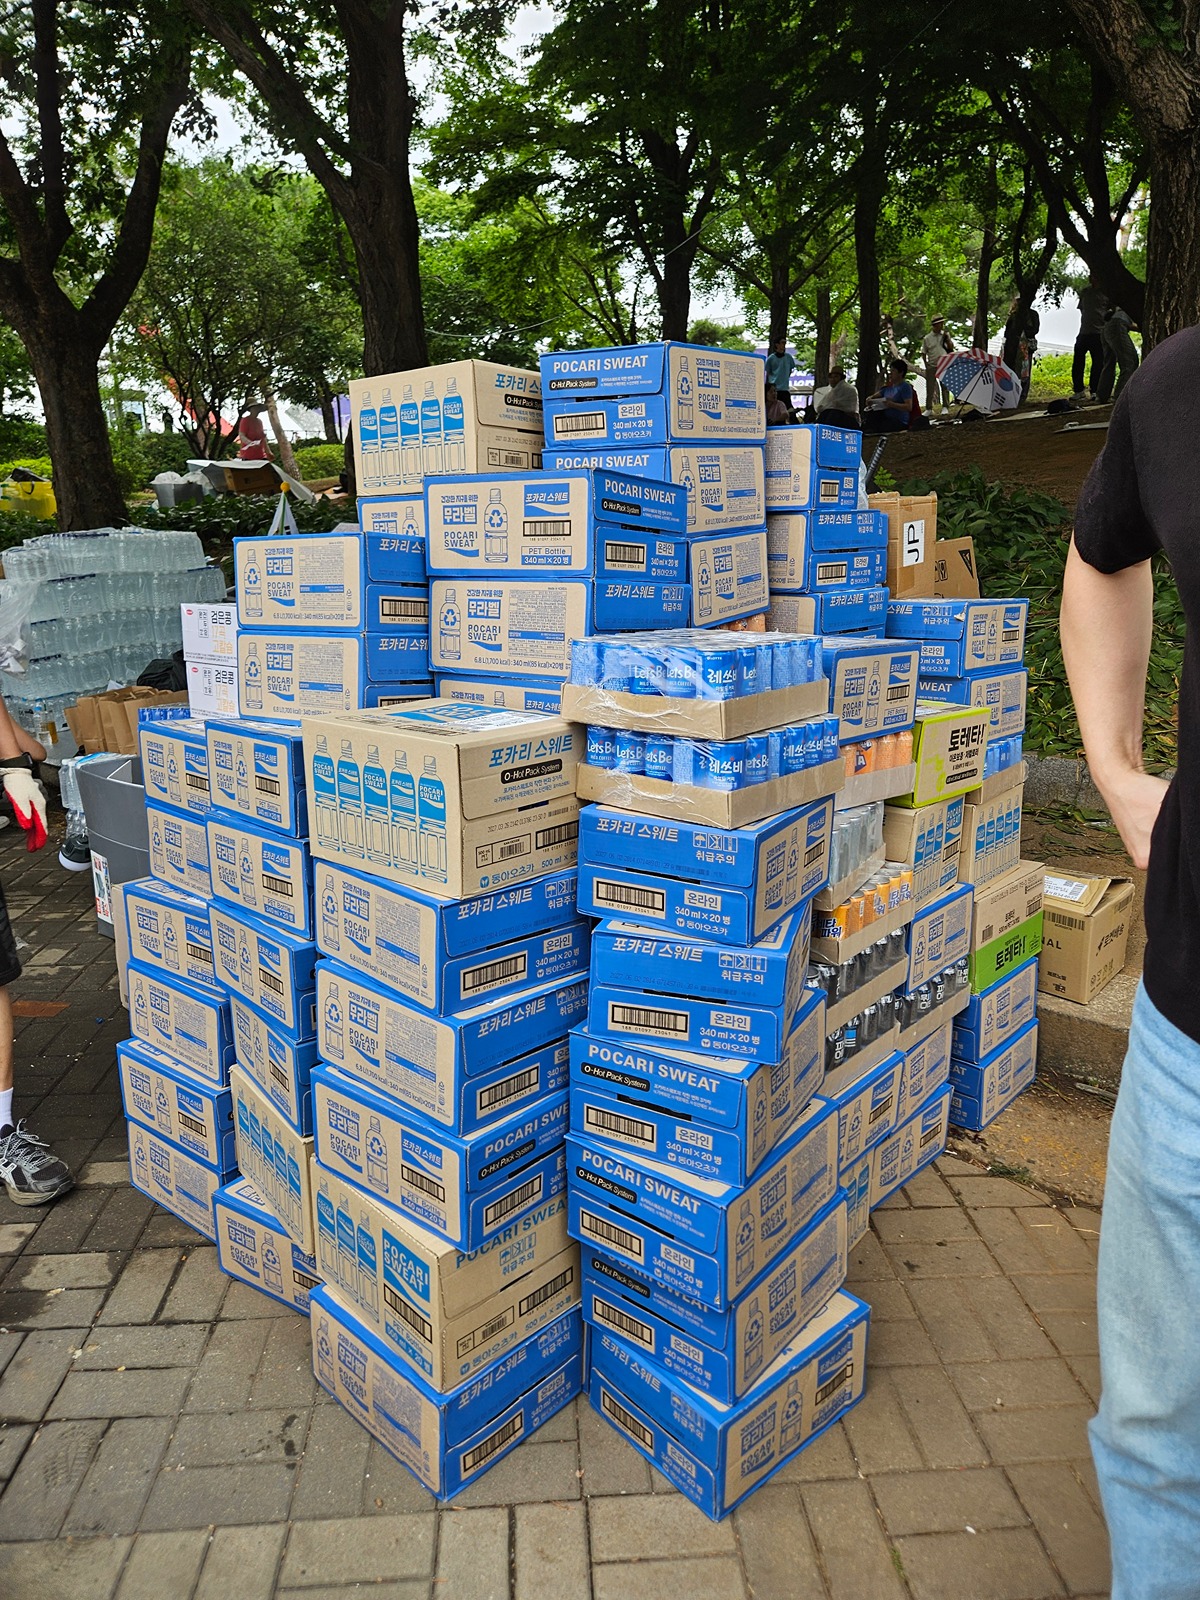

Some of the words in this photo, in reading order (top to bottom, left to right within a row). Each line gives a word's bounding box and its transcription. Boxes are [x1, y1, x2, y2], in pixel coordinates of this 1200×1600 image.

[553, 359, 600, 373] POCARI
[603, 355, 649, 369] SWEAT
[495, 373, 528, 393] 포카리
[698, 393, 721, 402] POCARI
[698, 402, 719, 410] SWEAT
[620, 404, 644, 417] 온라인
[556, 457, 603, 469] POCARI
[605, 455, 650, 467] SWEAT
[525, 492, 546, 502] 포카리
[546, 492, 568, 502] 스웨트
[605, 479, 642, 498] POCARI
[643, 488, 676, 504] SWEAT
[701, 488, 722, 496] POCARI
[444, 505, 476, 524] 무라벨
[444, 531, 478, 539] POCARI
[444, 539, 475, 547] SWEAT
[379, 538, 410, 553] 포카리
[658, 543, 674, 555] 온라인
[267, 589, 291, 597] SWEAT
[605, 585, 630, 599] 포카리
[631, 586, 655, 599] 스웨트
[830, 596, 846, 606] 포카리
[847, 593, 864, 604] 스웨트
[468, 600, 500, 618] 무라벨
[662, 602, 682, 612] 취급주의
[211, 610, 232, 626] 검은콩
[467, 625, 501, 633] POCARI
[467, 633, 498, 641] SWEAT
[215, 670, 234, 685] 검은콩
[267, 676, 293, 684] POCARI
[267, 684, 290, 692] SWEAT
[842, 701, 864, 711] POCARI
[842, 710, 861, 719] SWEAT
[948, 724, 985, 752] 토레타!
[488, 741, 532, 768] 포카리
[534, 734, 574, 758] 스웨트
[709, 757, 743, 774] 레쓰비
[420, 784, 444, 797] POCARI
[596, 818, 636, 835] 포카리
[638, 823, 679, 843] 스웨트
[696, 850, 736, 866] 취급주의
[491, 864, 535, 883] 동아오츠카
[343, 892, 370, 921] 무라벨
[457, 899, 499, 920] 포카리
[499, 887, 533, 910] 스웨트
[688, 892, 719, 909] 온라인
[675, 907, 689, 915] 340
[710, 914, 721, 923] 20
[343, 927, 369, 944] SWEAT
[344, 918, 370, 936] POCARI
[687, 920, 728, 936] 동아오츠카
[546, 935, 571, 953] 온라인
[612, 937, 656, 955] 포카리
[658, 945, 704, 963] 스웨트
[995, 935, 1026, 971] 토레타!
[545, 959, 578, 977] 동아오츠카
[721, 969, 764, 984] 취급주의
[349, 1002, 378, 1033] 무라벨
[477, 1017, 512, 1039] 포카리
[514, 997, 547, 1021] 스웨트
[714, 1013, 747, 1030] 온라인
[349, 1027, 378, 1049] POCARI
[700, 1027, 716, 1037] 340
[737, 1032, 749, 1043] 20
[350, 1035, 376, 1055] SWEAT
[712, 1039, 757, 1056] 동아오츠카
[584, 1065, 605, 1078] O-Hot
[606, 1072, 624, 1084] Pack
[624, 1075, 647, 1090] System
[588, 1044, 654, 1074] POCARI
[658, 1065, 720, 1093] SWEAT
[329, 1109, 359, 1140] 무라벨
[329, 1133, 361, 1156] POCARI
[485, 1118, 538, 1159] POCARI
[678, 1128, 709, 1147] 온라인
[330, 1142, 359, 1161] SWEAT
[666, 1141, 681, 1151] 340
[701, 1150, 713, 1161] 20
[678, 1155, 719, 1175] 동아오츠카
[582, 1149, 641, 1186] POCARI
[645, 1178, 701, 1214] SWEAT
[407, 1191, 420, 1203] PET
[421, 1198, 441, 1215] Bottle
[760, 1200, 787, 1229] POCARI
[229, 1225, 255, 1251] 무라벨
[230, 1245, 257, 1264] POCARI
[231, 1253, 255, 1269] SWEAT
[383, 1237, 429, 1285] POCARI
[502, 1251, 535, 1276] 취급주의
[664, 1247, 692, 1268] 온라인
[383, 1249, 424, 1293] SWEAT
[393, 1320, 404, 1335] PET
[674, 1337, 701, 1363] 온라인
[601, 1334, 629, 1364] 포카리
[630, 1356, 661, 1392] 스웨트
[458, 1372, 493, 1409] 포카리
[495, 1349, 528, 1381] 스웨트
